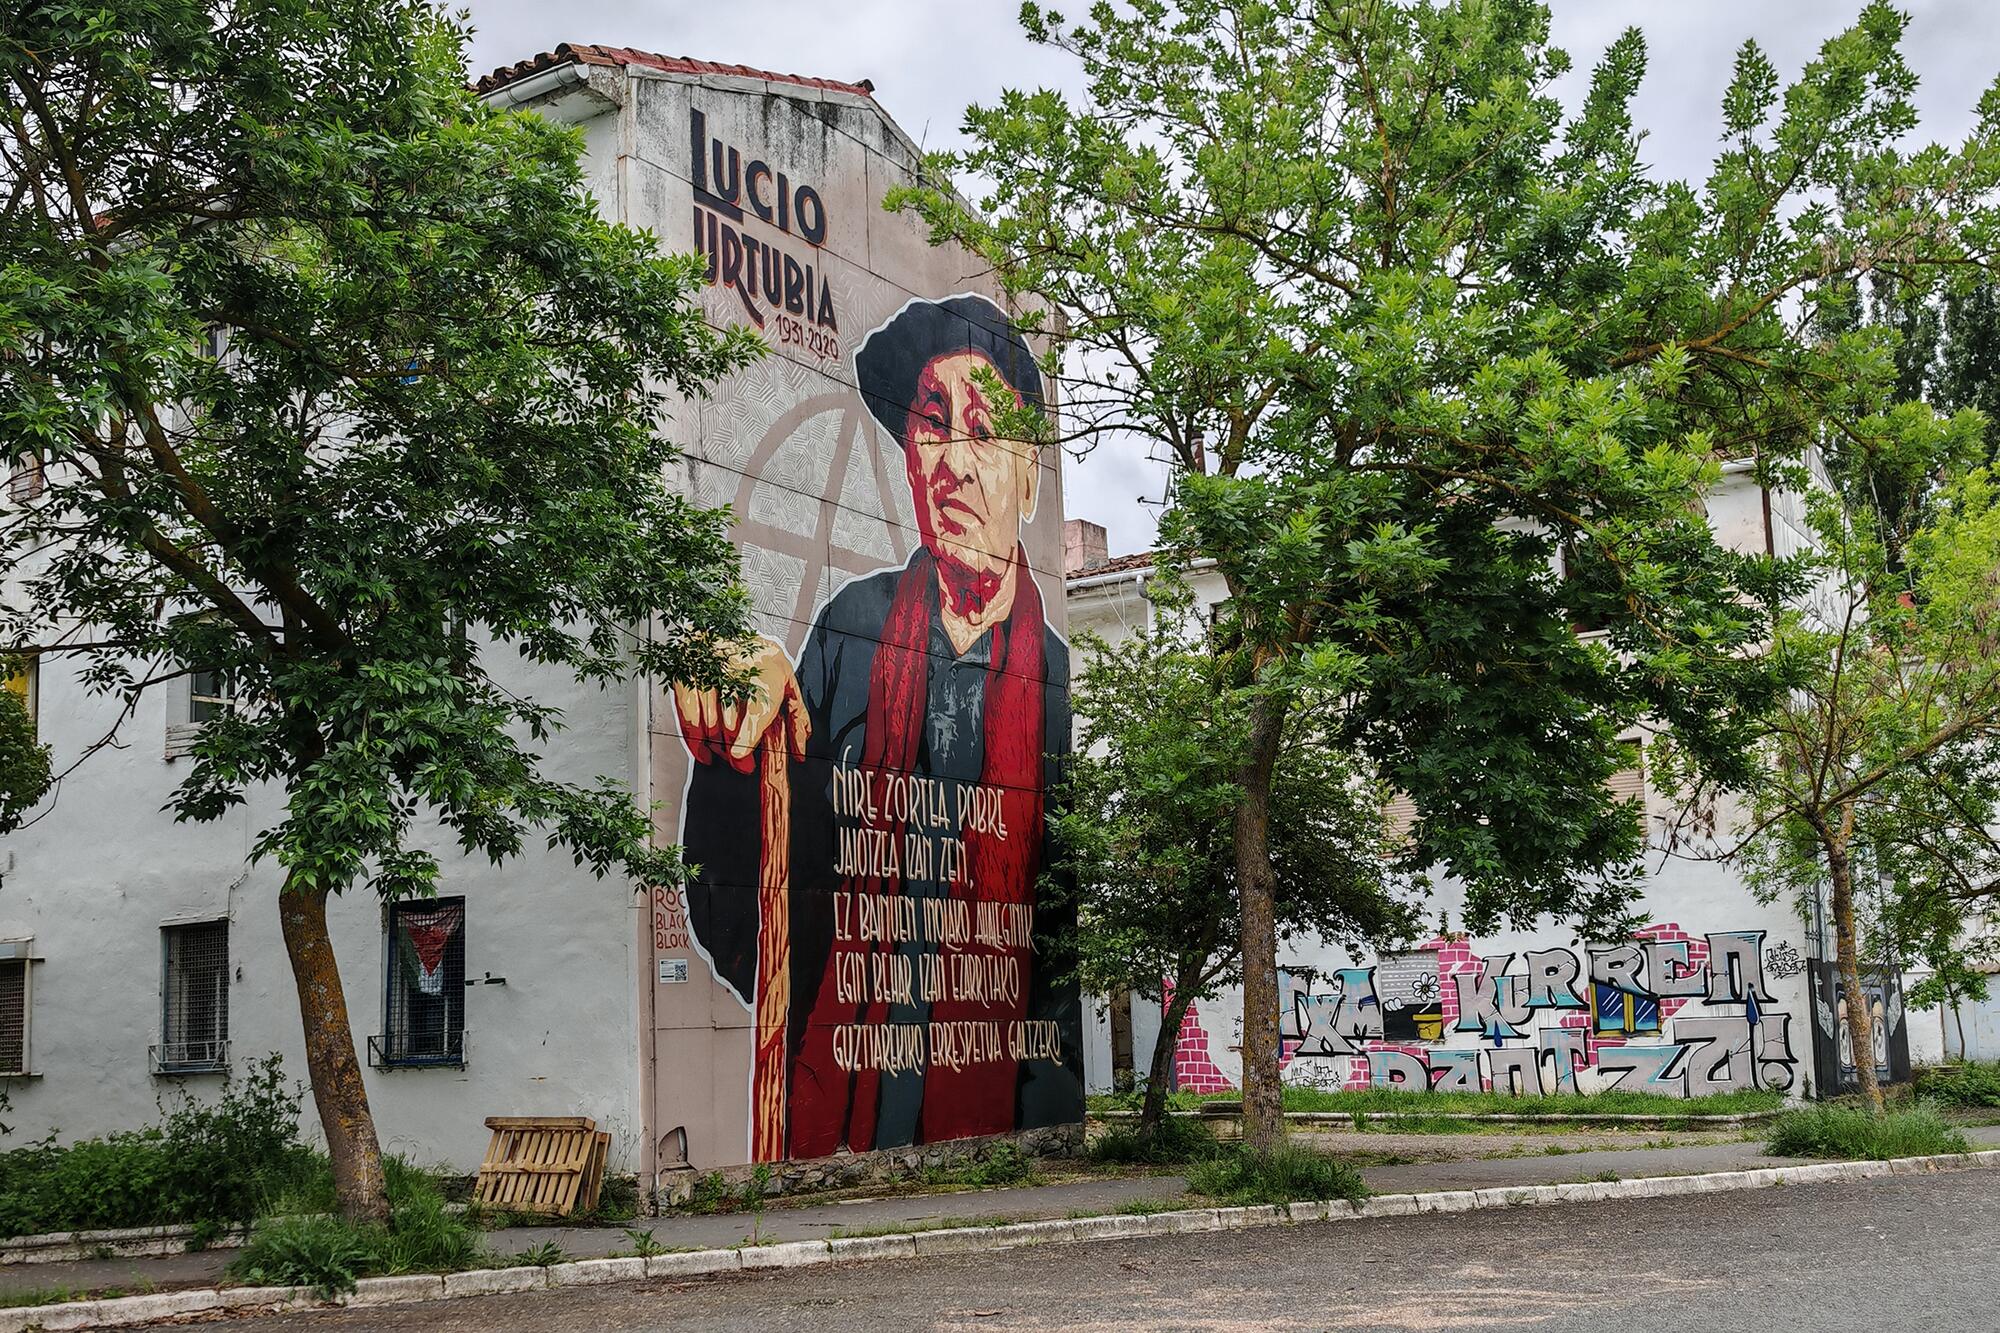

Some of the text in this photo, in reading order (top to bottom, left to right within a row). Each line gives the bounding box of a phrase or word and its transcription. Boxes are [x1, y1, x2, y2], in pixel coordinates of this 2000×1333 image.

[691, 107, 828, 247] LUCIO
[693, 205, 838, 334] URTUBIA
[775, 313, 839, 360] 1931-2020
[833, 745, 1008, 841] NIRE ZORTEA POBRE
[833, 826, 900, 879] JAIOTZEA
[905, 833, 933, 881] IZAN
[655, 912, 689, 931] BLACK
[655, 931, 690, 950] BLOCK
[833, 892, 1040, 955] EZ BAINUEN INOLAKO AHALEGINIK
[835, 951, 1020, 1010] EGIN BEHAR IZAN EZARRITAKO
[833, 1020, 1063, 1078] GUZTIAREKIKO ERRESPETUA GALTZEKO
